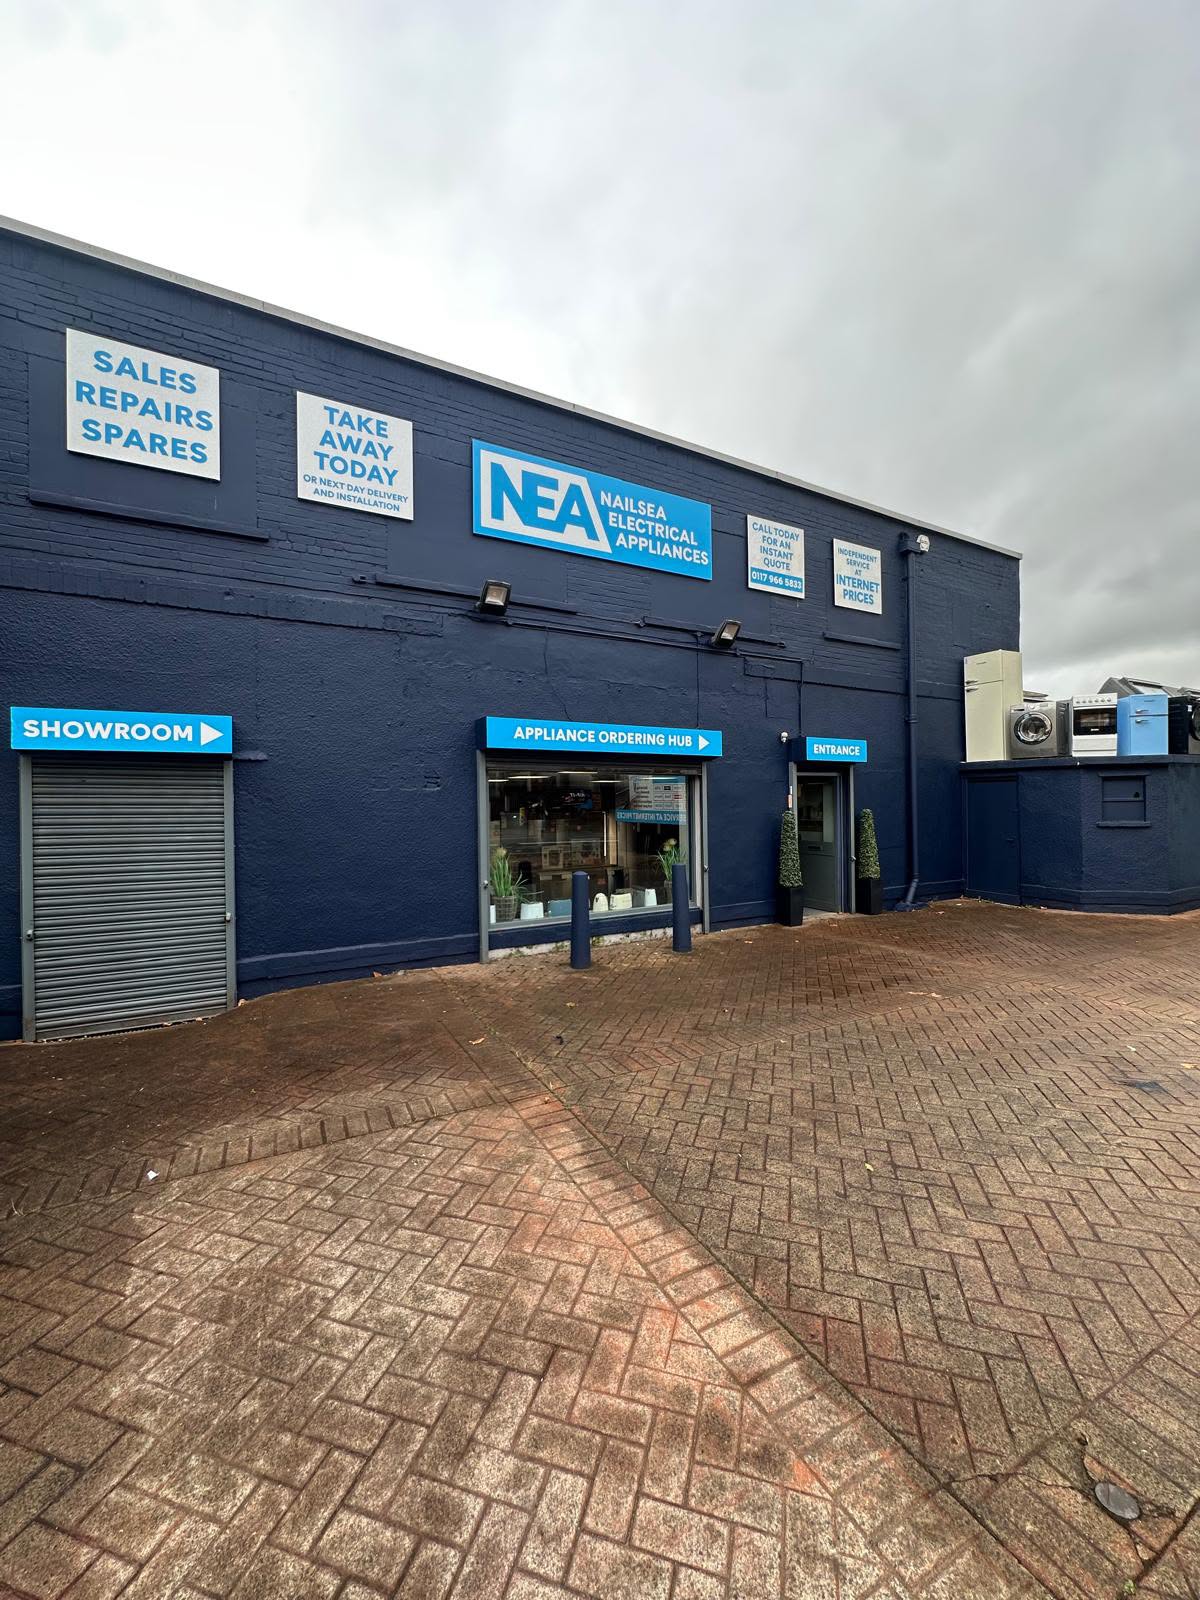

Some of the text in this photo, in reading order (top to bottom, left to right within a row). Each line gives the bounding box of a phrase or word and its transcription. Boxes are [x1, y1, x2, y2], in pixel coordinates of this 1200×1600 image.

[93, 350, 197, 395] SALES
[75, 380, 214, 432] REPAIRS
[323, 405, 388, 439] TAKE
[81, 418, 208, 464] SPARES
[319, 430, 394, 462] AWAY
[313, 450, 399, 487] TODAY
[303, 474, 408, 503] OR NEXT DAY DELIVERY
[313, 488, 400, 512] AND INSTALLATION
[490, 461, 600, 542] NEA
[600, 490, 667, 521] NAILSEA
[608, 511, 698, 546] ELECTRICAL
[752, 522, 800, 542] CALL TODAY
[615, 531, 709, 566] APPLIANCES
[760, 545, 794, 561] INSTANT
[762, 535, 791, 550] FOR AN
[763, 557, 791, 571] QUOTE
[837, 547, 877, 563] INDEPENDENT
[846, 558, 870, 570] SERVICE
[751, 570, 802, 589] 0117 966 5833
[836, 573, 880, 593] INTERNET
[843, 589, 874, 605] PRICES
[23, 719, 193, 742] SHOWROOM
[513, 726, 693, 747] APPLIANCE ORDERING HUB
[813, 744, 860, 756] ENTRANCE
